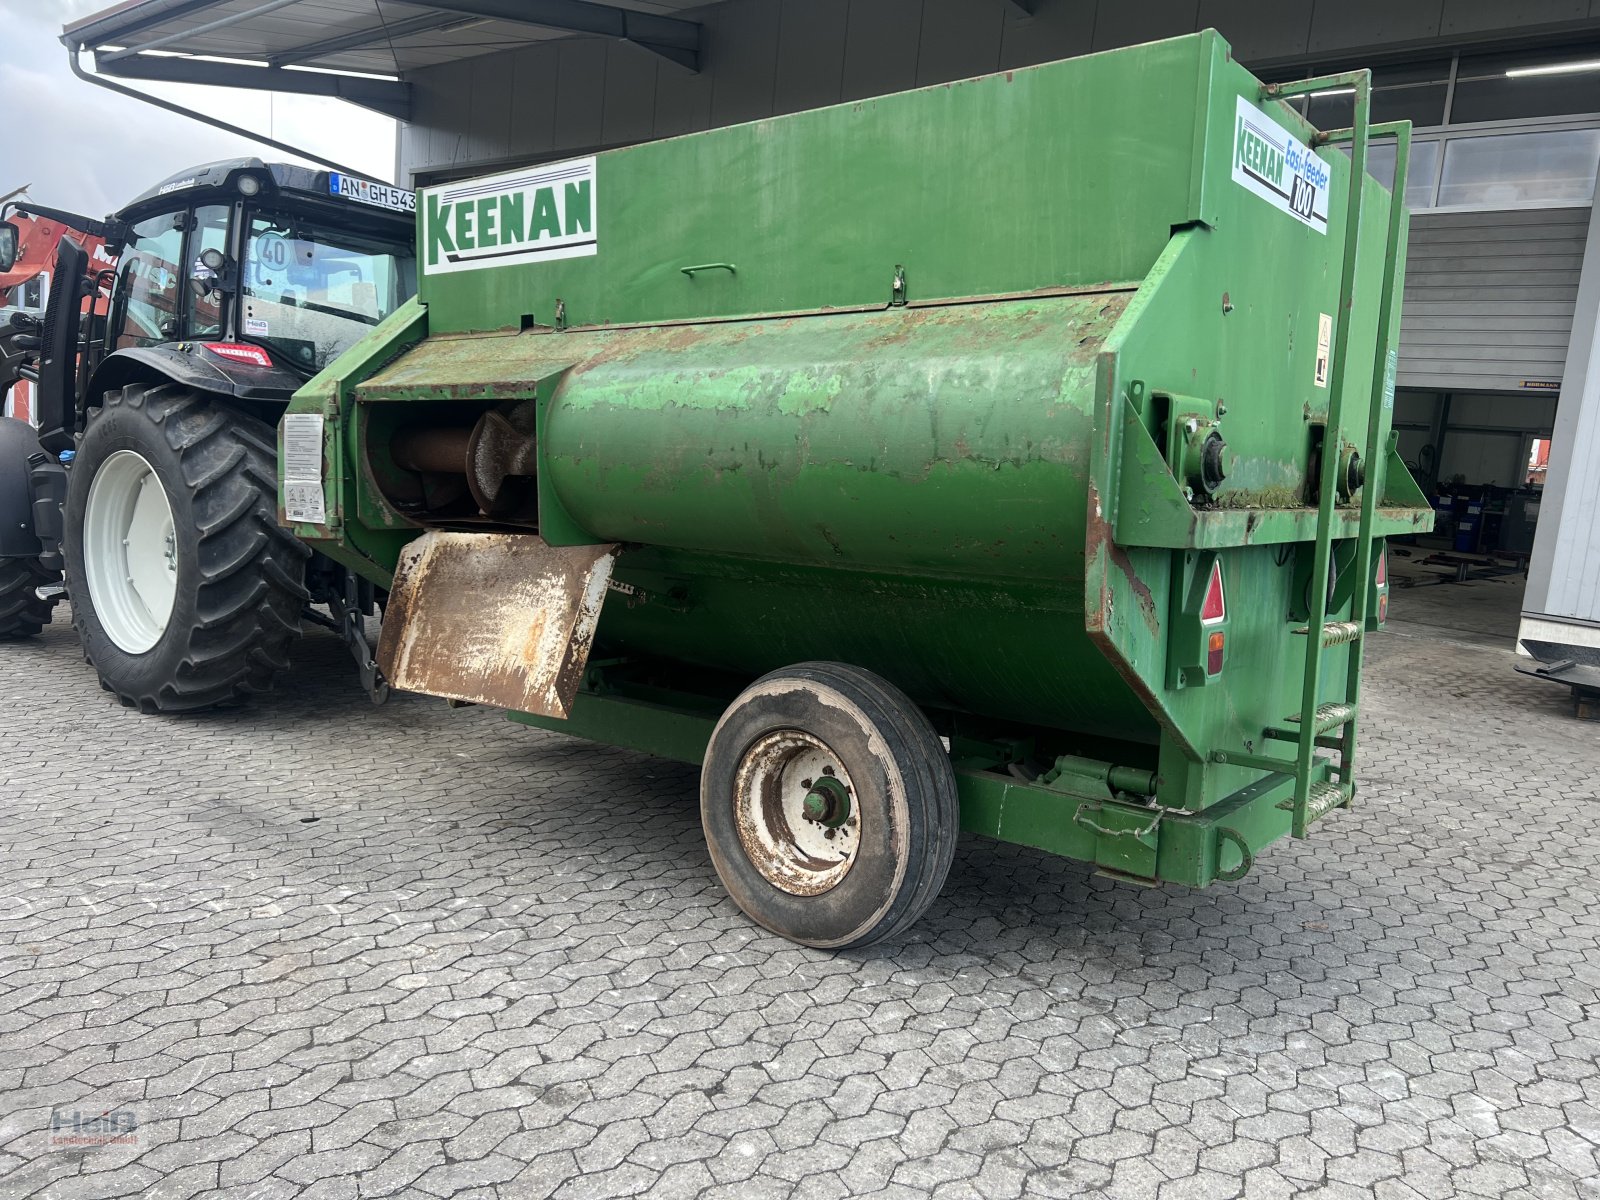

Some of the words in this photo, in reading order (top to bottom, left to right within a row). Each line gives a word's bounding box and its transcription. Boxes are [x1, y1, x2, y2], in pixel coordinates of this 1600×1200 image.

[1234, 115, 1284, 188] KEENAN
[1285, 139, 1328, 191] Easi-feeder
[341, 178, 360, 197] AN
[369, 185, 388, 204] GH
[391, 189, 416, 210] 543
[1293, 179, 1314, 217] 100
[427, 179, 592, 266] KEENAN
[262, 237, 286, 266] 40
